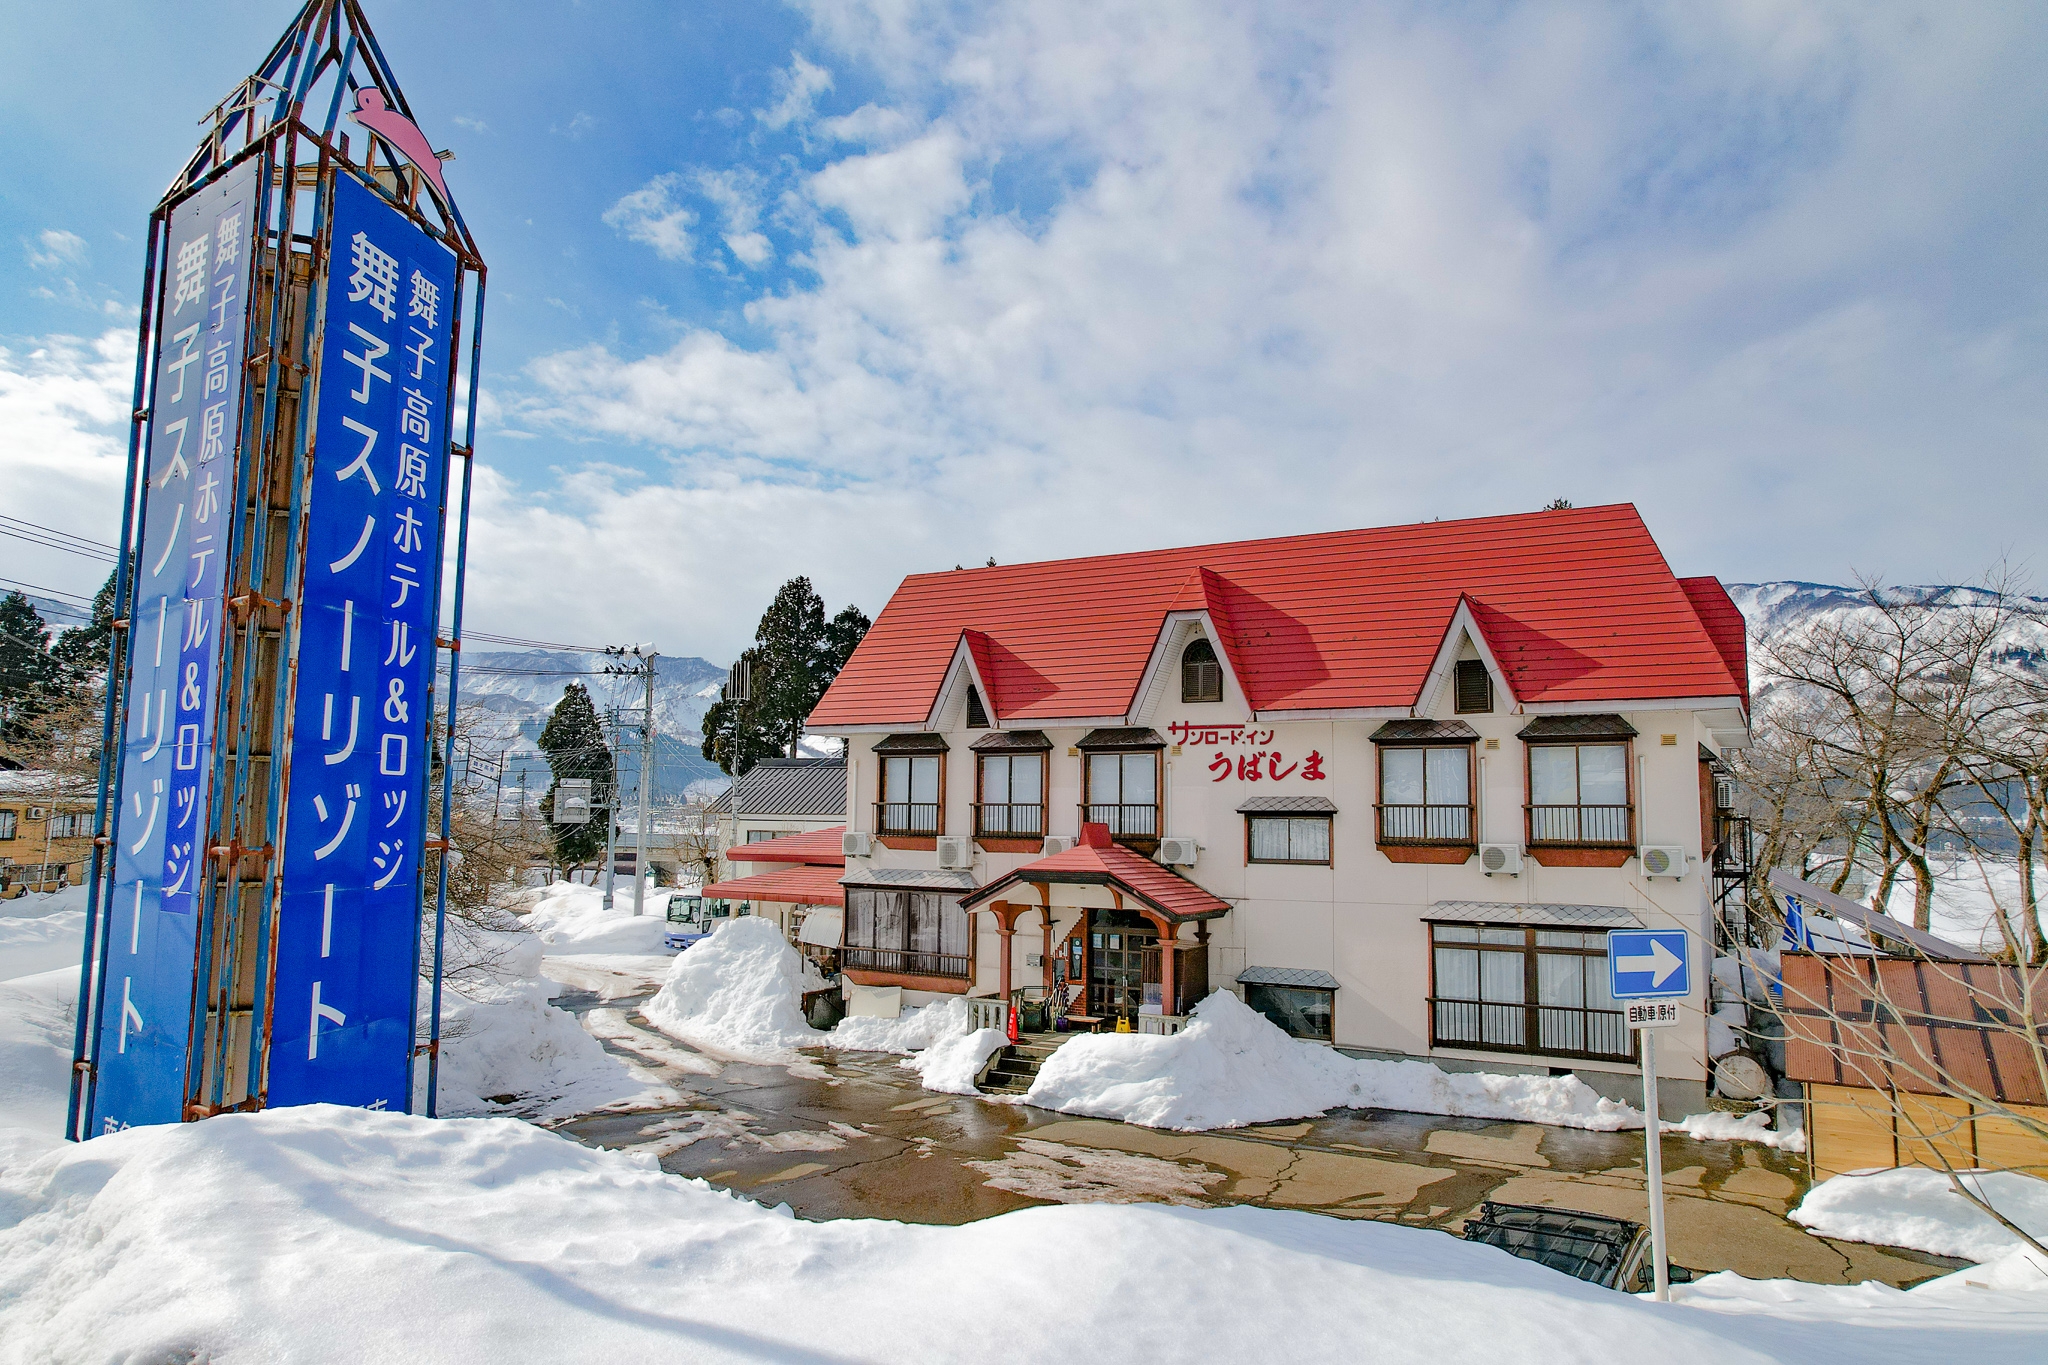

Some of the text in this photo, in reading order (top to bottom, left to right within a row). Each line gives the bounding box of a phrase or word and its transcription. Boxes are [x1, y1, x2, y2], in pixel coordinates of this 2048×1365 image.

[118, 233, 209, 1054] 舞子スノーリゾート
[166, 212, 242, 898] 舞子高原ホテル&ロッジ
[308, 231, 399, 1061] 舞子スノーリゾート
[374, 270, 441, 891] 舞子高原ホテル&ロッジ
[1208, 750, 1326, 782] うばしま
